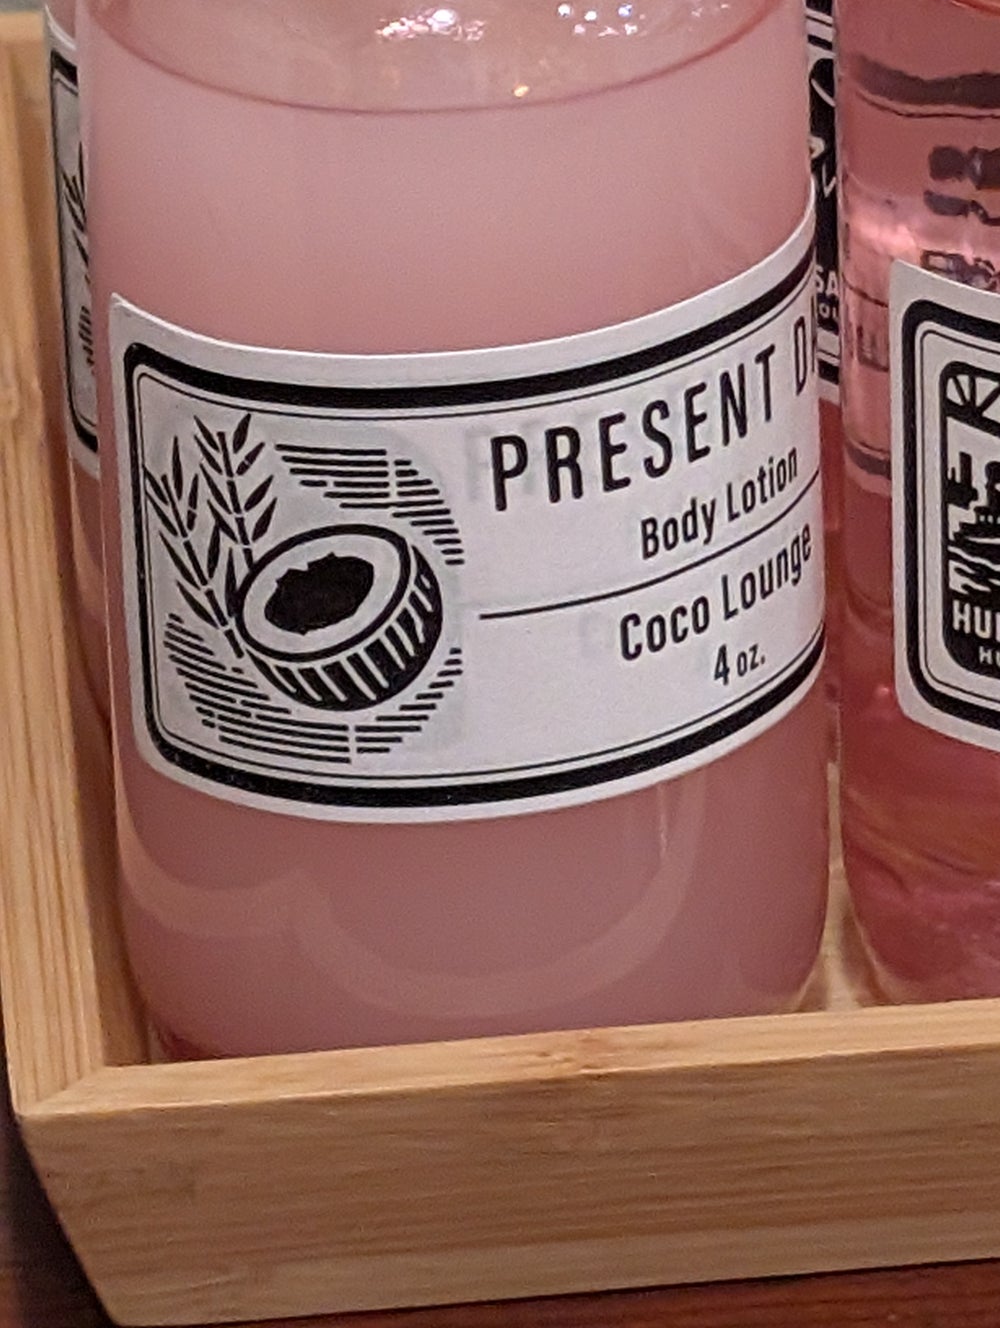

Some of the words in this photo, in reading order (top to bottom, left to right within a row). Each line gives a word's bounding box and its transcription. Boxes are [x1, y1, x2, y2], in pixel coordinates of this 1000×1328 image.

[491, 343, 776, 511] PRESENT
[640, 496, 716, 560] Body
[727, 447, 798, 523] Lotion
[619, 595, 711, 662] Coco
[720, 522, 813, 622] Lounge
[714, 643, 731, 687] 4
[736, 642, 767, 678] oz.
